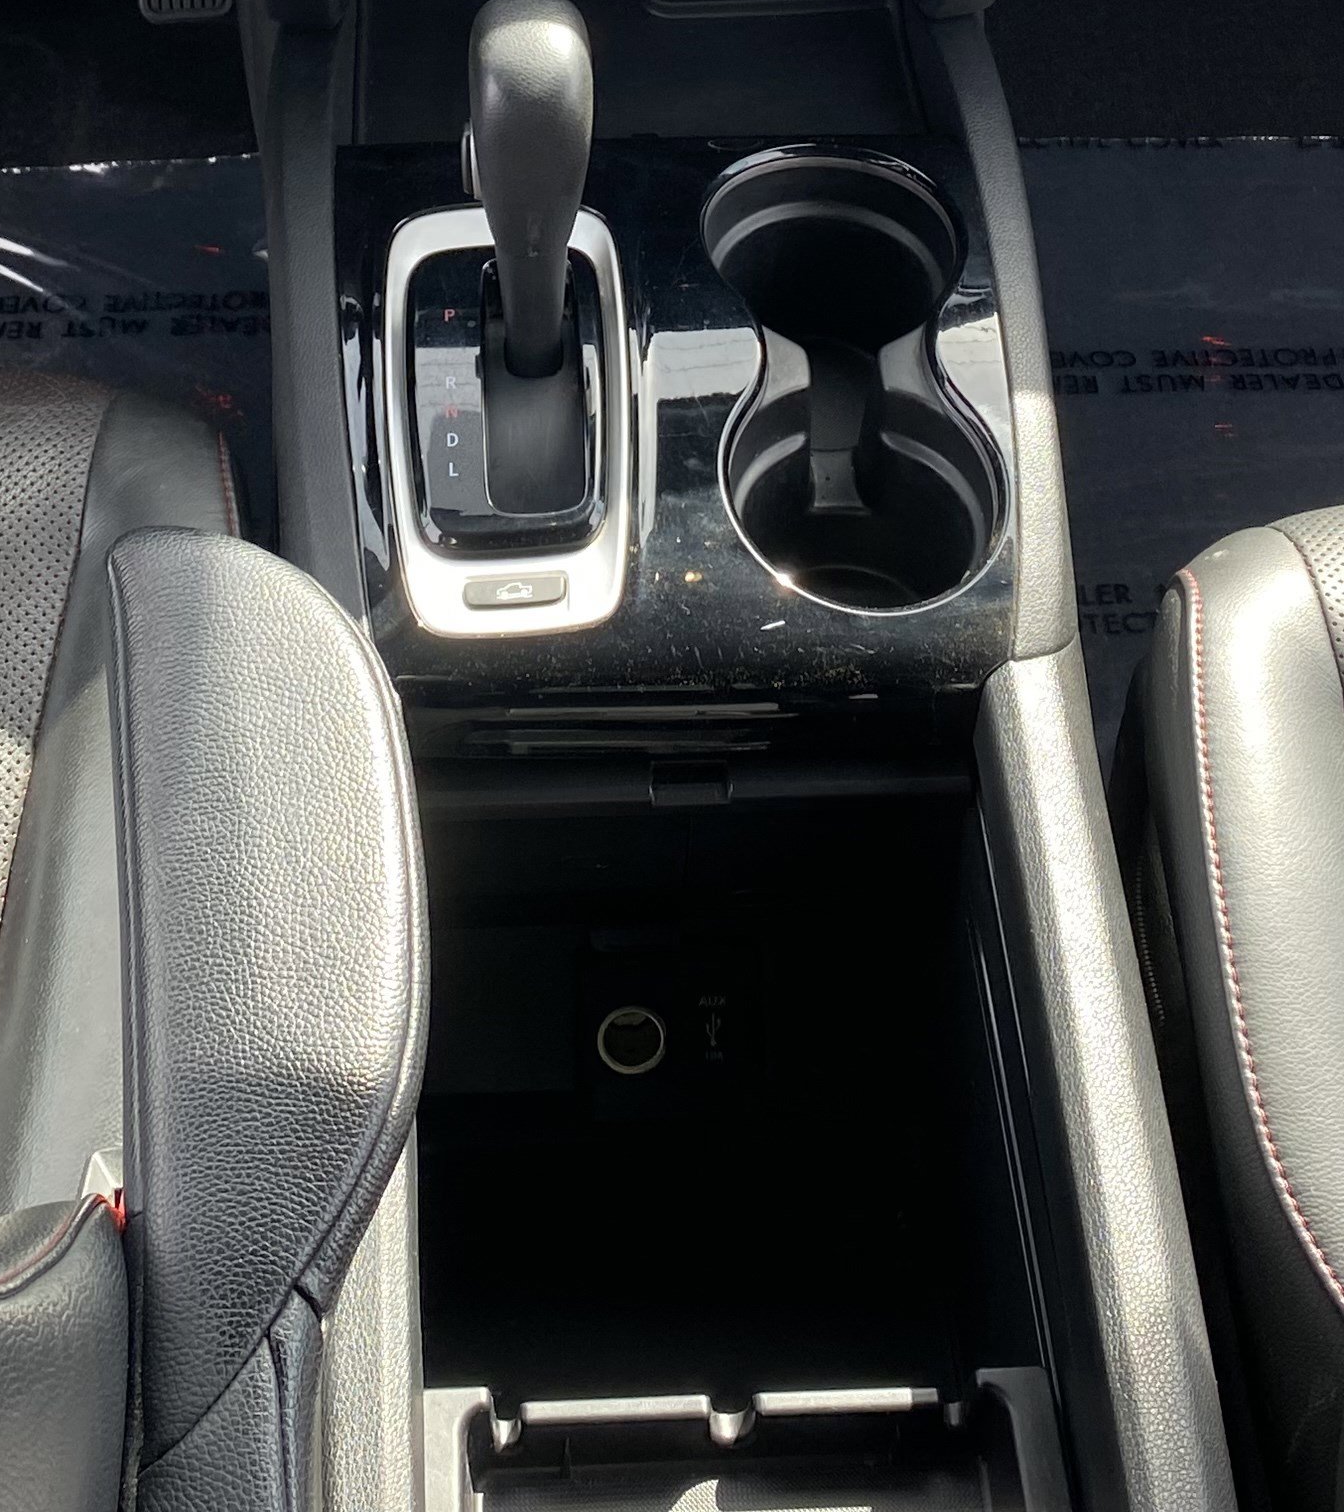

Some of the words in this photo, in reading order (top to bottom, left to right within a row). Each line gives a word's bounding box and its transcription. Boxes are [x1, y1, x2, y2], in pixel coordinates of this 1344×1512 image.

[444, 309, 455, 322] P
[1123, 373, 1205, 392] MUST
[447, 433, 458, 447] D
[449, 462, 459, 477] L
